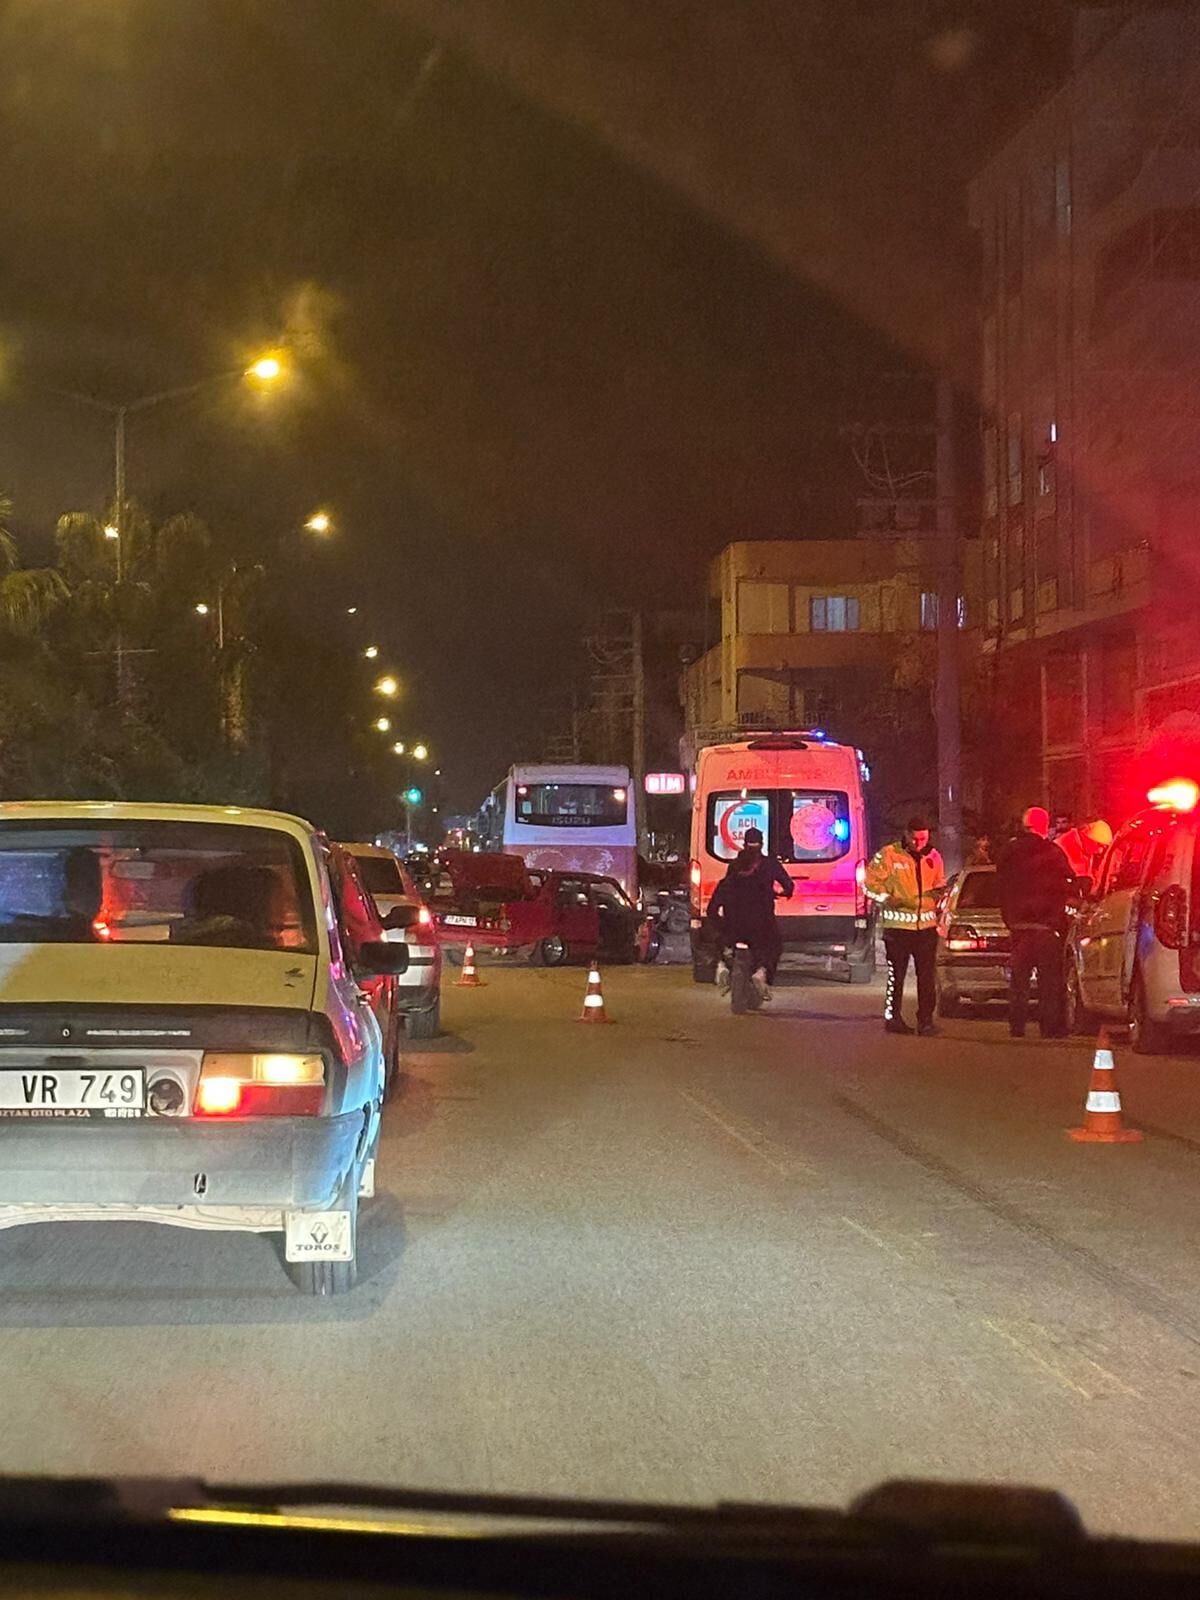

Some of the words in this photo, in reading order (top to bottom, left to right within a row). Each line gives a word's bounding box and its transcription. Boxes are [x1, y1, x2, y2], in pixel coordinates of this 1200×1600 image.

[21, 1075, 57, 1103] VR
[80, 1075, 137, 1103] 749
[31, 1109, 53, 1117] OTO
[54, 1109, 91, 1117] PLAZA
[295, 1244, 340, 1252] TOROS
